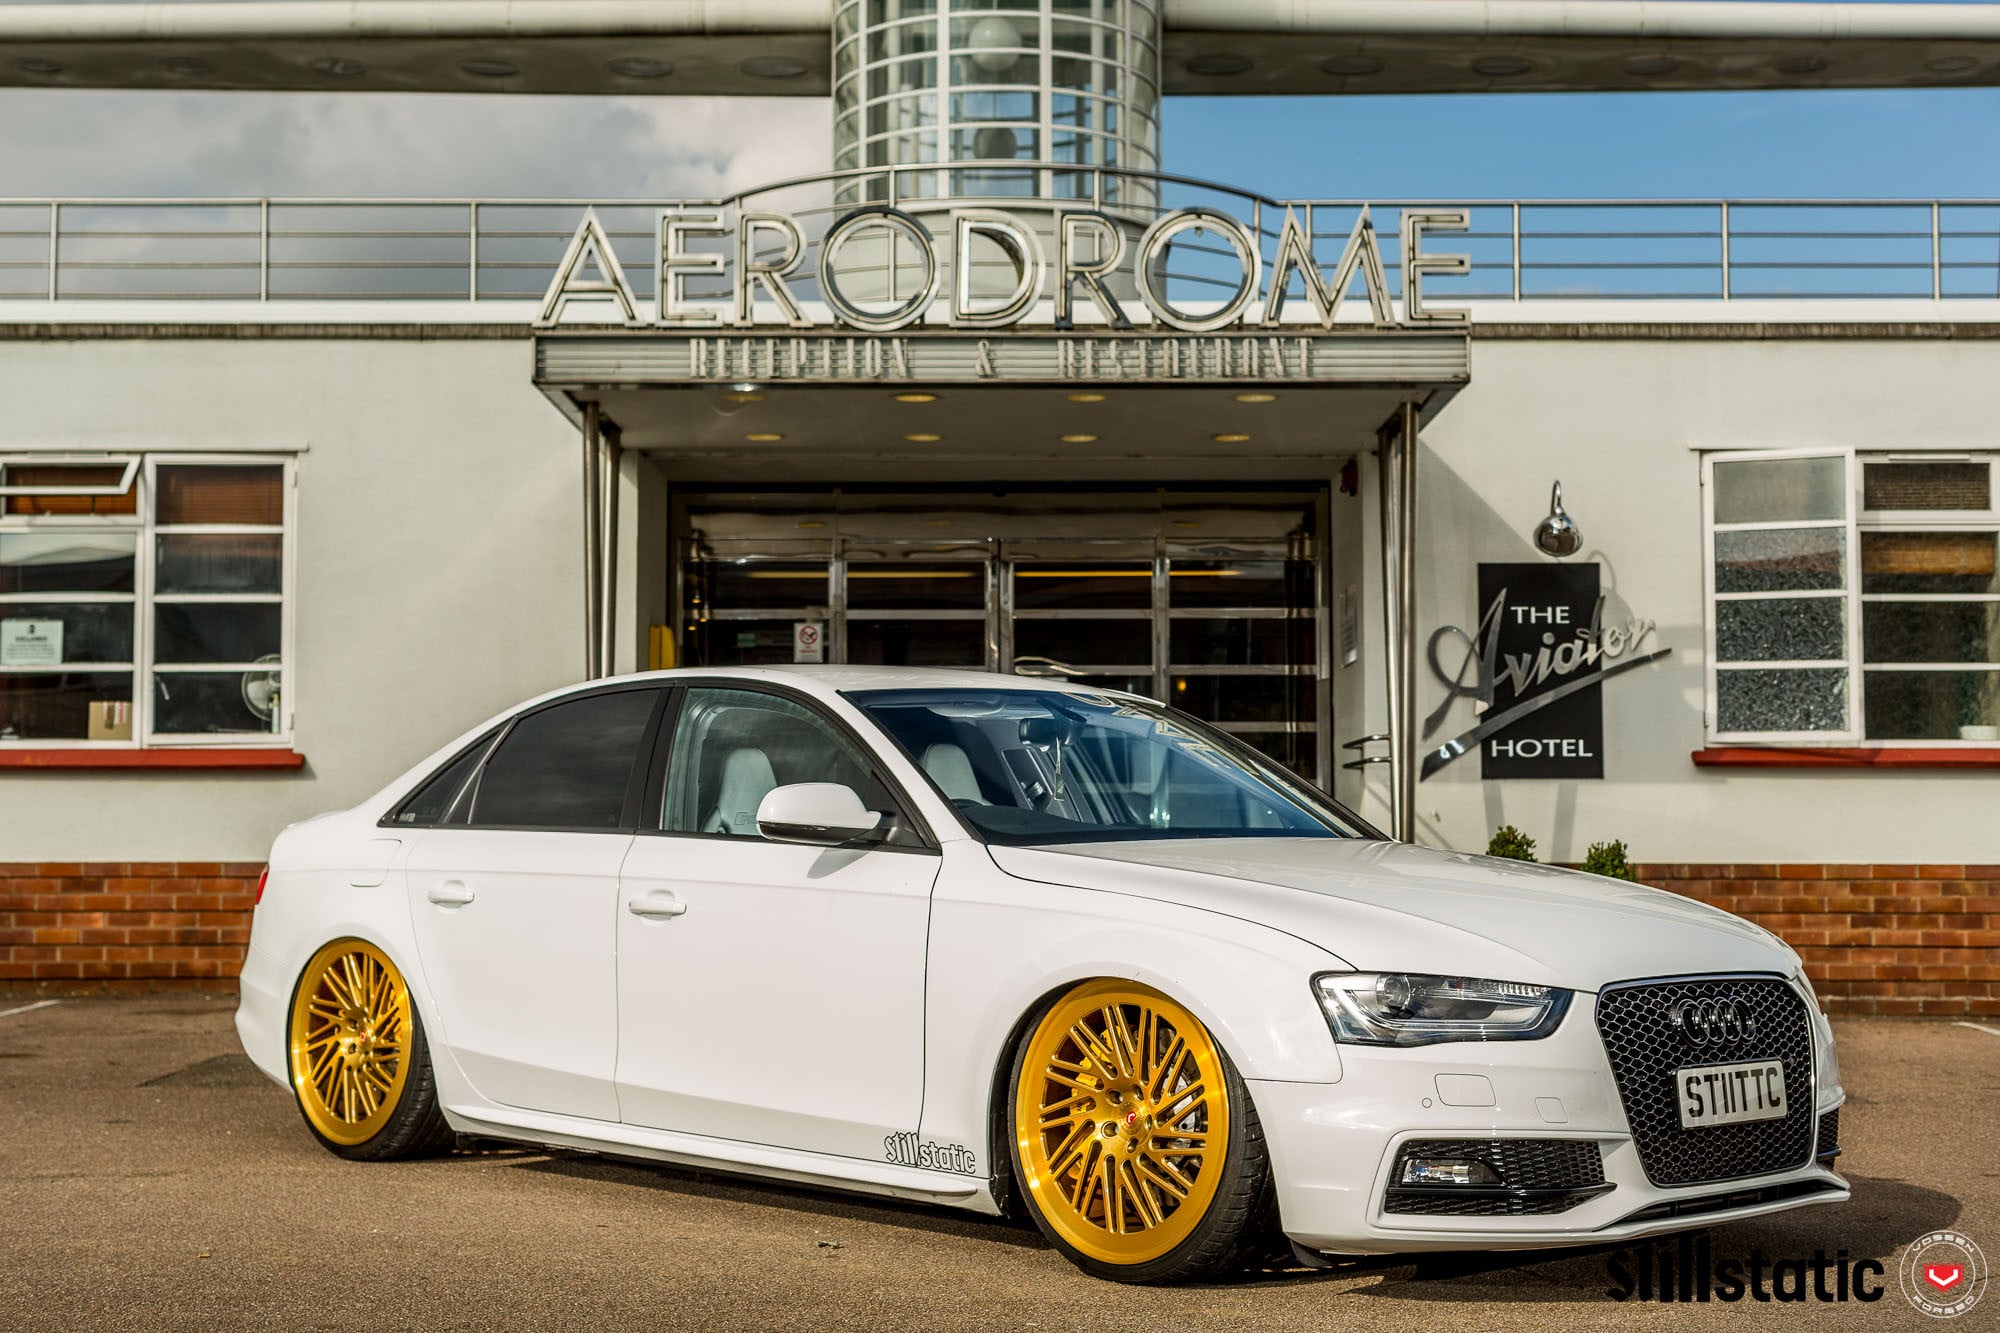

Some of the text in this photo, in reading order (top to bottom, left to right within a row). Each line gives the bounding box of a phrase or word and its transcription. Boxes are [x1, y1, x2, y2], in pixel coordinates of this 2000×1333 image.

[532, 203, 1472, 332] AERODROME
[689, 338, 1314, 378] RECEPTION & RESTAURANT
[1510, 606, 1570, 624] THE
[1422, 587, 1656, 742] Aviator
[1490, 738, 1593, 757] HOTEL
